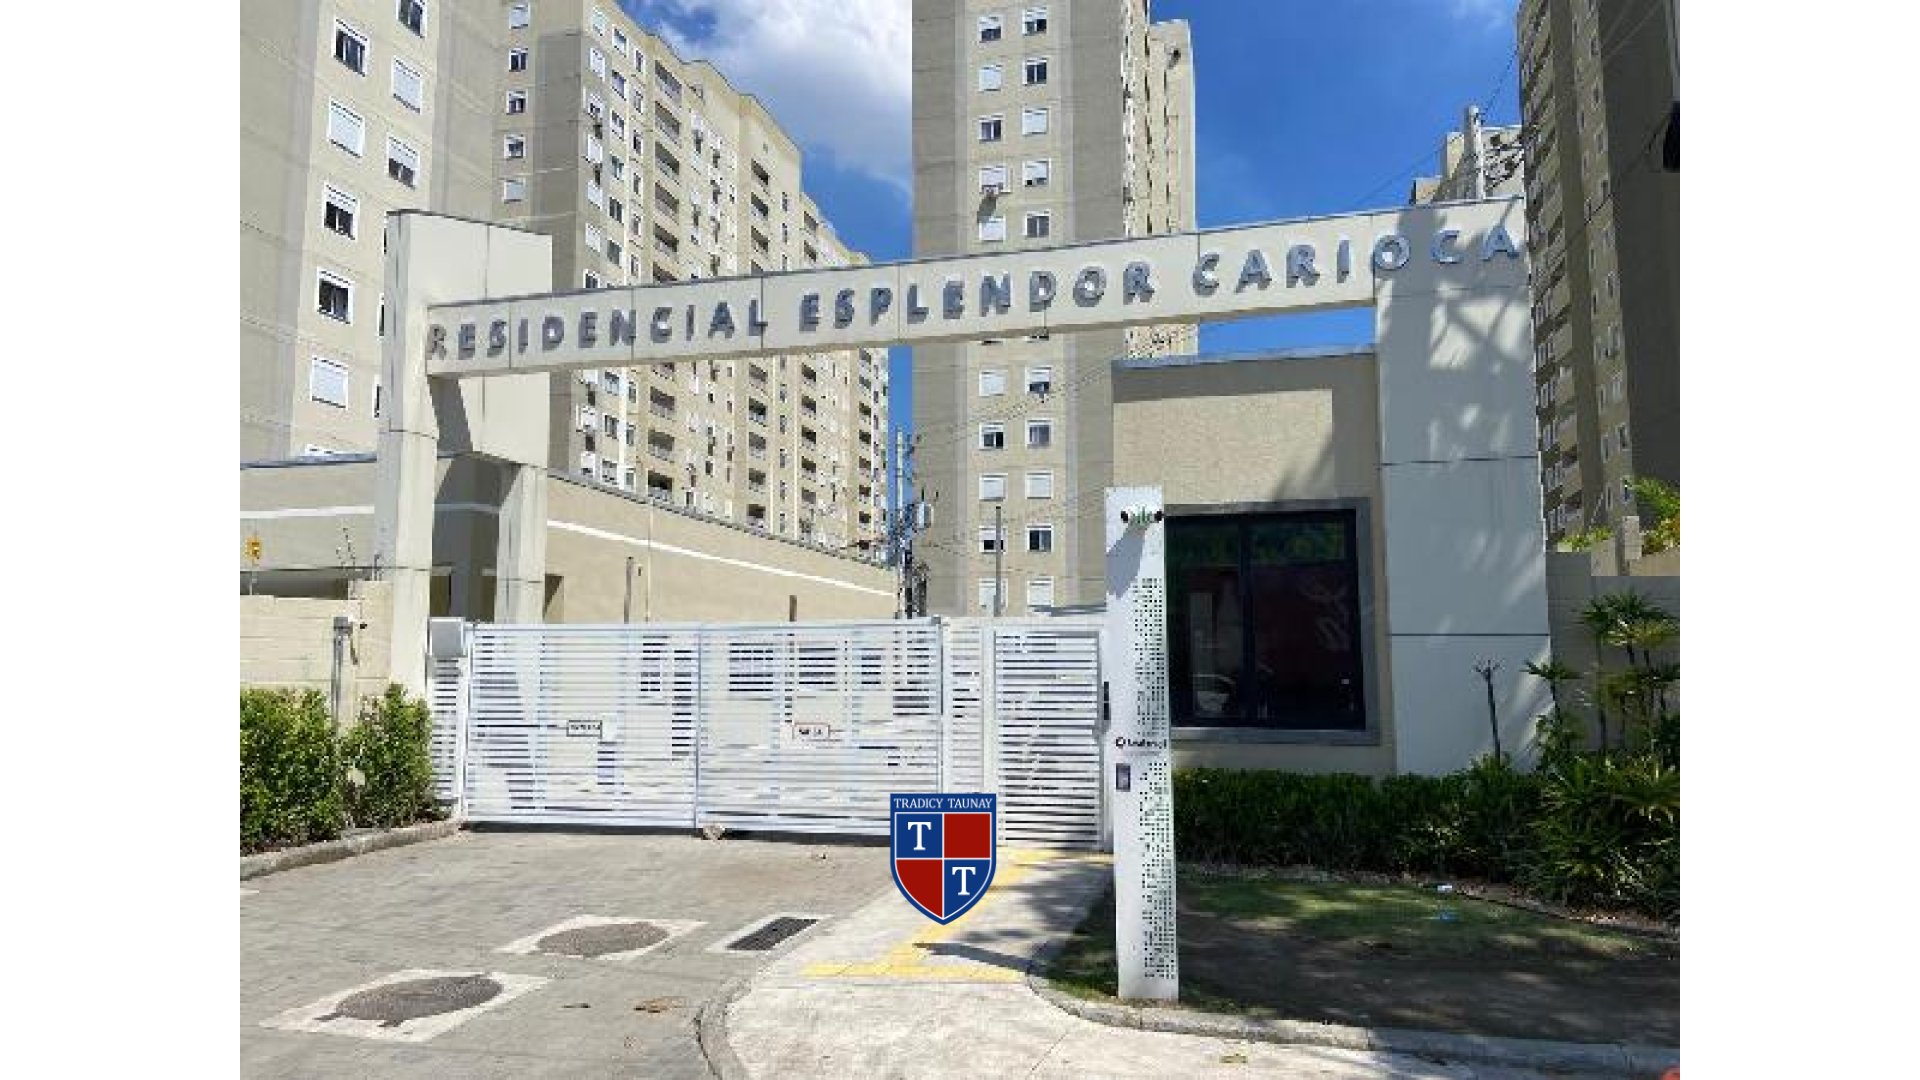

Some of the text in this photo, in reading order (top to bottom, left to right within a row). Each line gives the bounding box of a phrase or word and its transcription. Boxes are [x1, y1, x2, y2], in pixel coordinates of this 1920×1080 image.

[427, 226, 1520, 361] RESIDENCIAL ESPLENDOR CARIOCA
